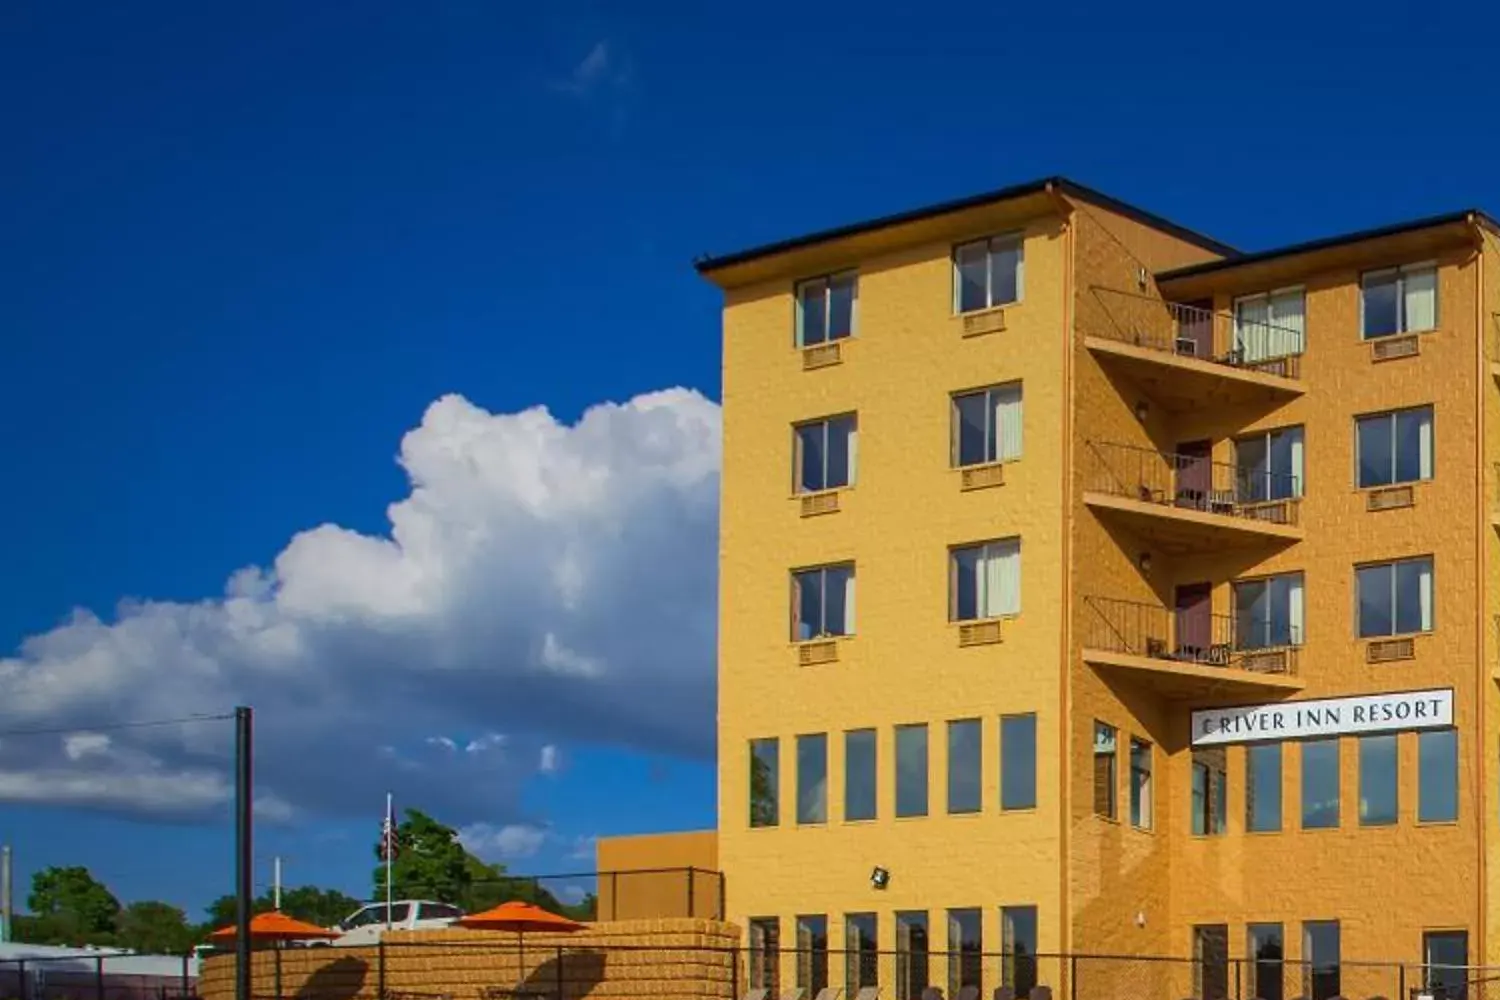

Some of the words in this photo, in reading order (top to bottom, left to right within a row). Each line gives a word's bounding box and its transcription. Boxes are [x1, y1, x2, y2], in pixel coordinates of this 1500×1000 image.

[1220, 711, 1284, 734] RIVER
[1297, 707, 1341, 728] INN
[1353, 699, 1443, 723] RESORT
